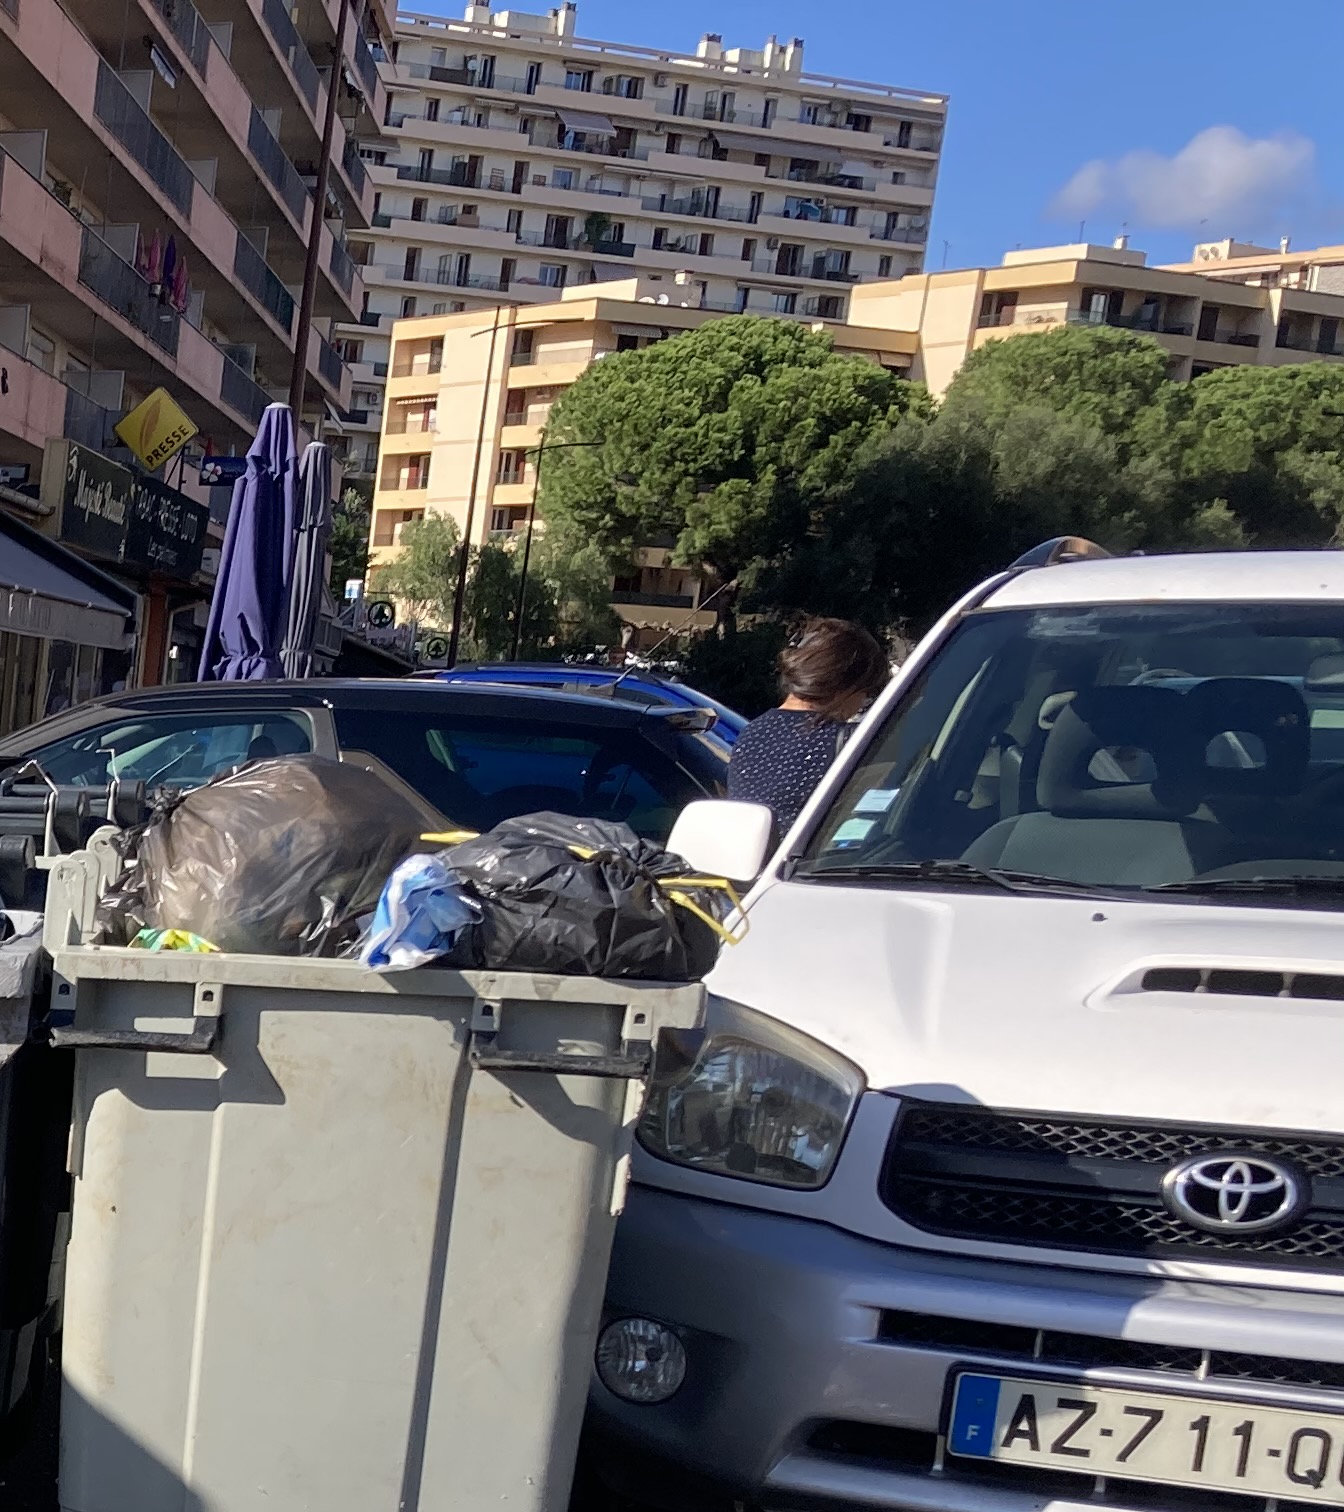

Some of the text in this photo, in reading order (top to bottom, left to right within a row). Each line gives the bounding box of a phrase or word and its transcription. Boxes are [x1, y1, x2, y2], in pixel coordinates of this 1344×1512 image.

[144, 424, 190, 467] PRESSE
[965, 1423, 980, 1441] F
[1000, 1393, 1344, 1490] AZ-711-Q
